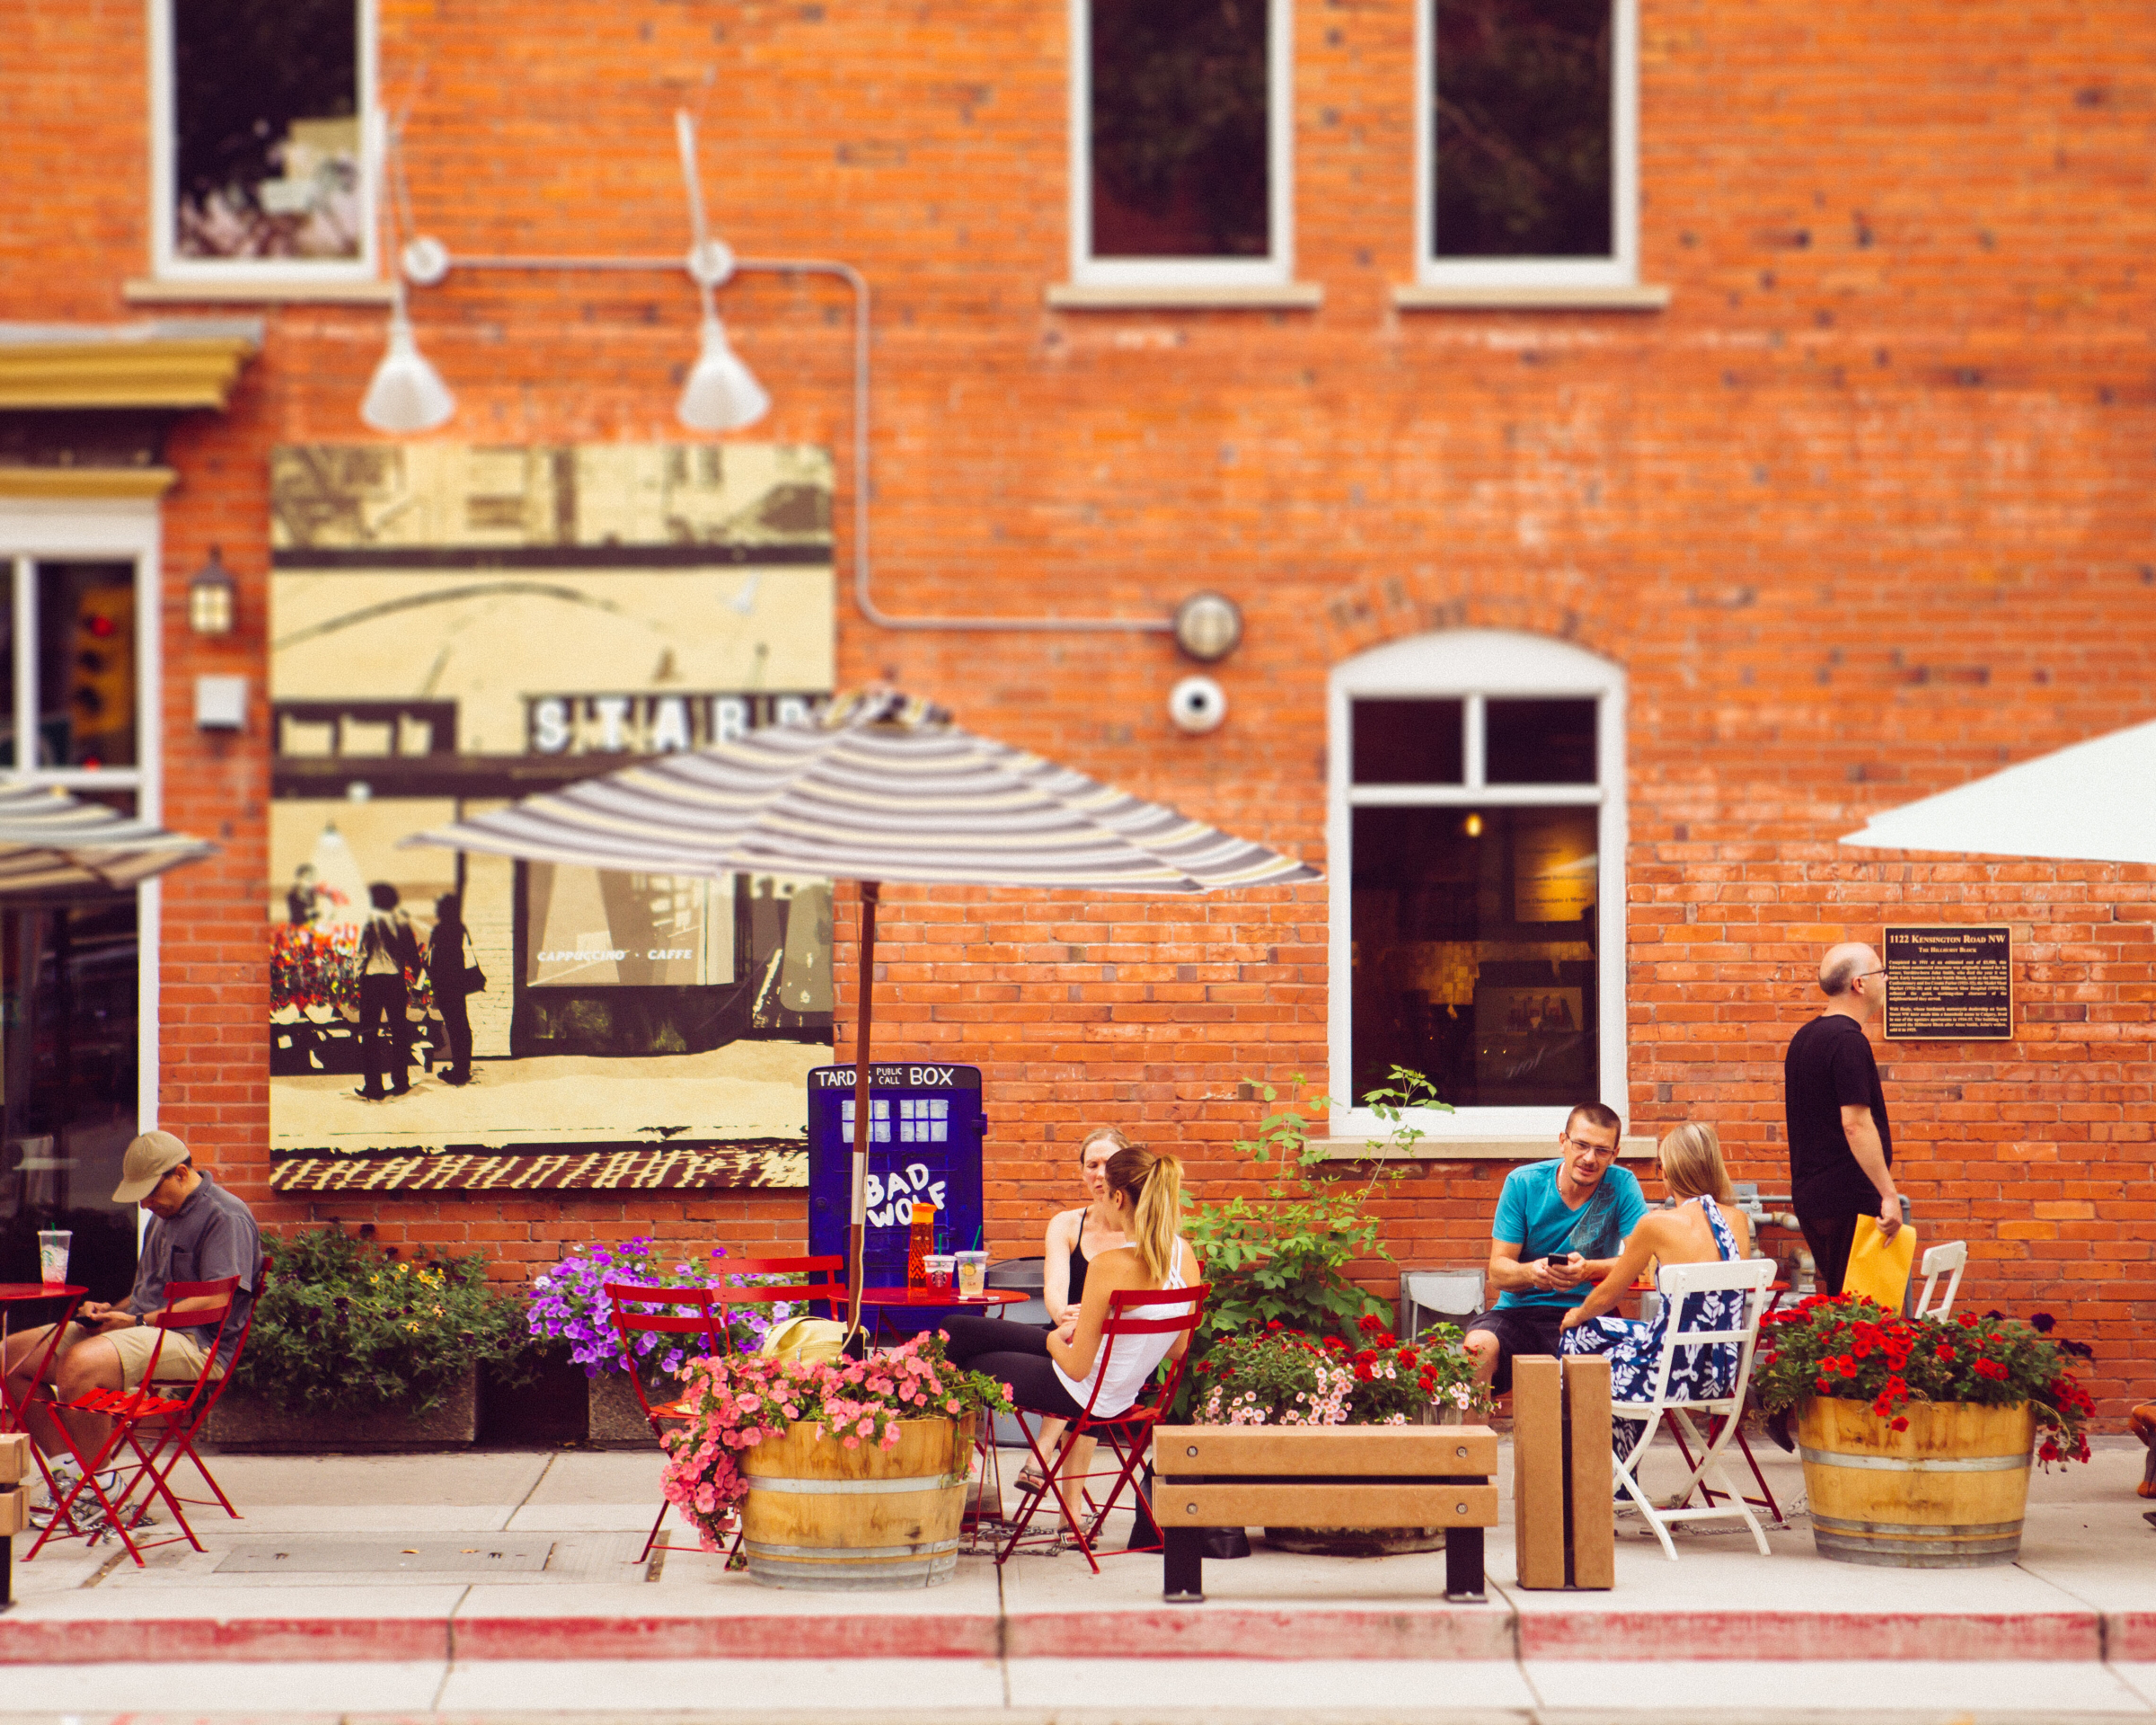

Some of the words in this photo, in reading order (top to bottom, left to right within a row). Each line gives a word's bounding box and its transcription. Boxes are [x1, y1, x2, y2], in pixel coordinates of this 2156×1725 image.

[1889, 934, 1910, 943] 1122
[1912, 934, 1961, 943] KENSINGTON
[1963, 934, 1986, 943] ROAD
[1988, 934, 2006, 943] NW
[537, 950, 626, 962] CAPPUCCINO
[647, 949, 694, 960] CAFFE
[876, 1067, 903, 1075] PUBLIC
[909, 1066, 954, 1086] BOX
[878, 1076, 900, 1085] CALL
[865, 1163, 929, 1208] BAD
